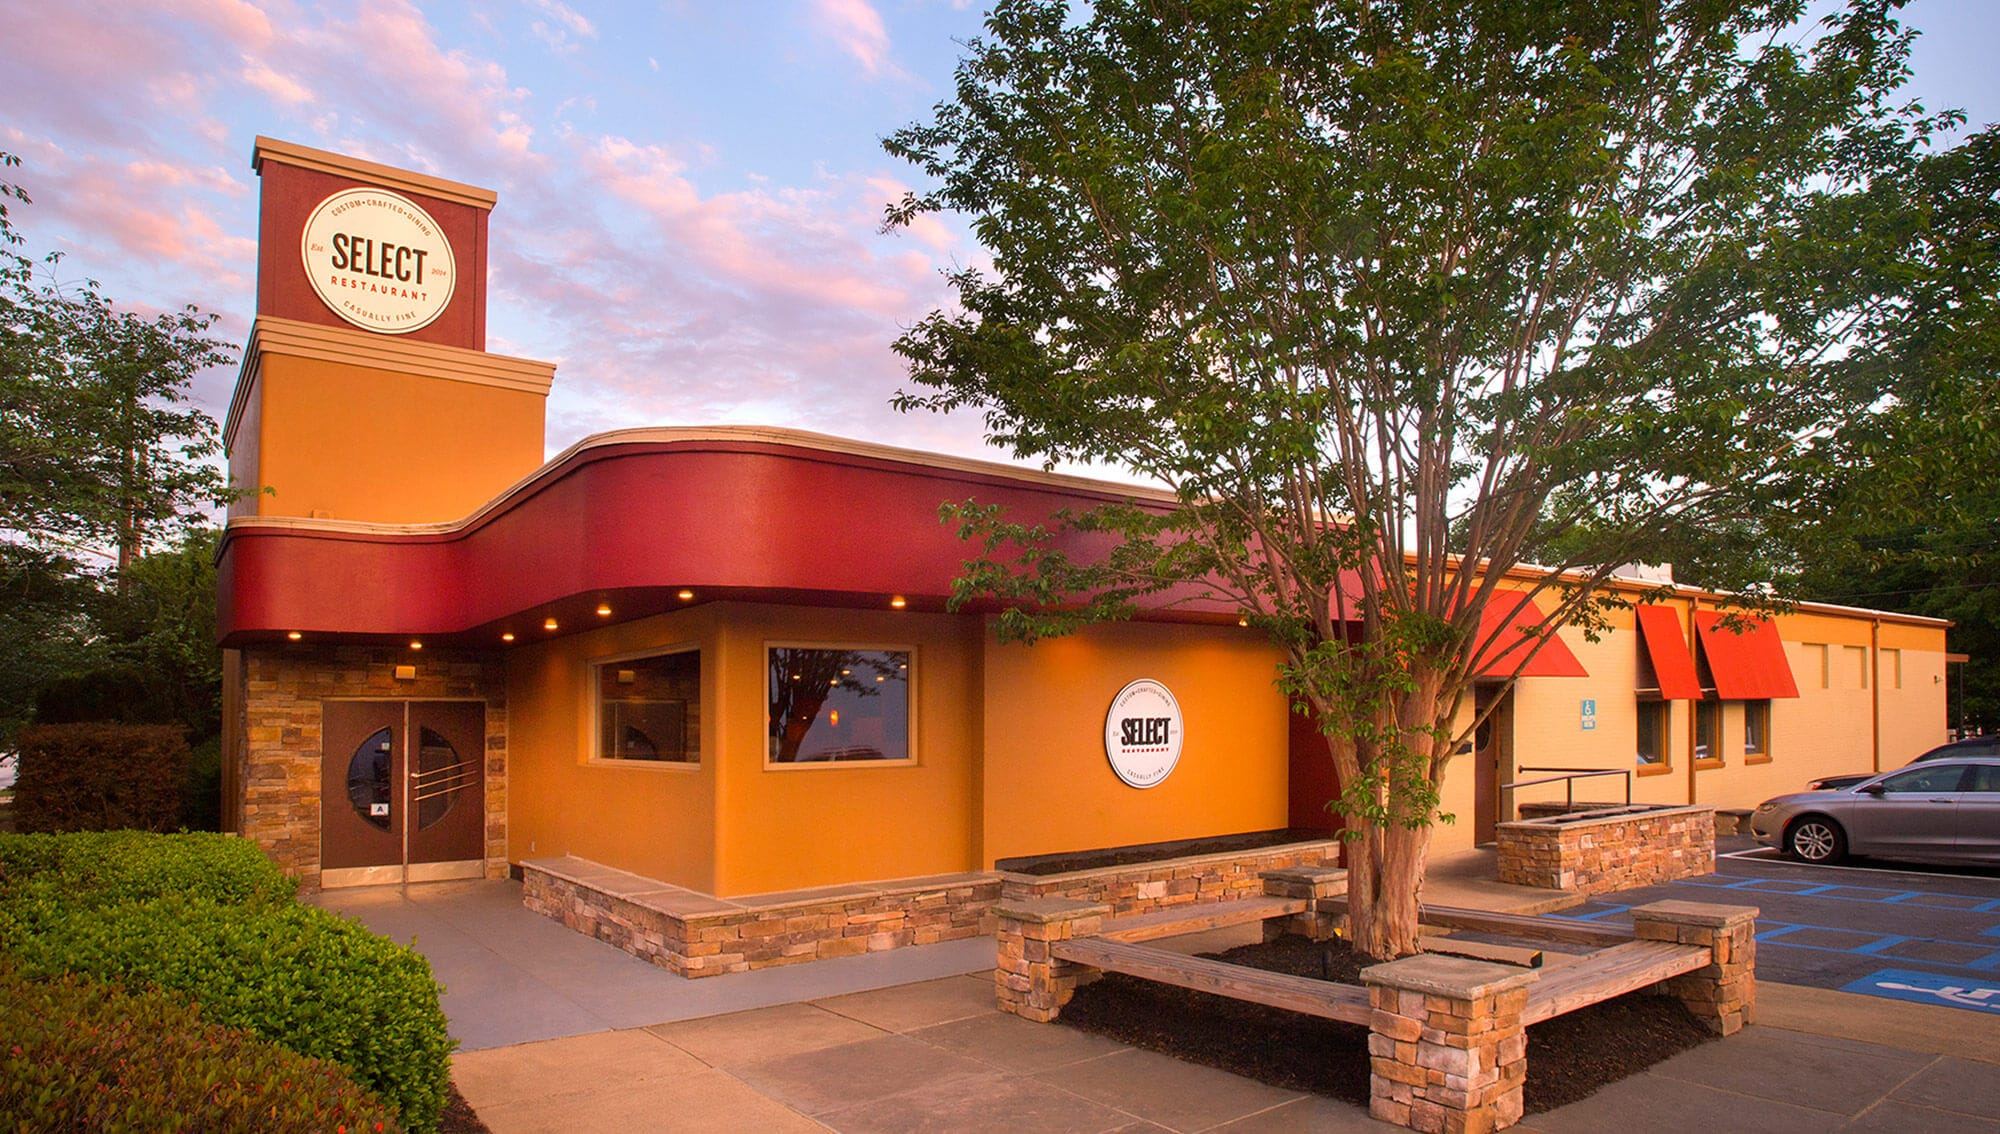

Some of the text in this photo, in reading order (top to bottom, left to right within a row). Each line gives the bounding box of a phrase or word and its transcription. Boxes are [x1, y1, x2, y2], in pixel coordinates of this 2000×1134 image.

[331, 198, 432, 237] CUSTOM CRAFTED DINING
[331, 232, 428, 285] SELECT
[330, 275, 428, 302] RESTAURANT
[343, 300, 417, 322] CASUALLY FINE
[1121, 717, 1171, 746] SELECT
